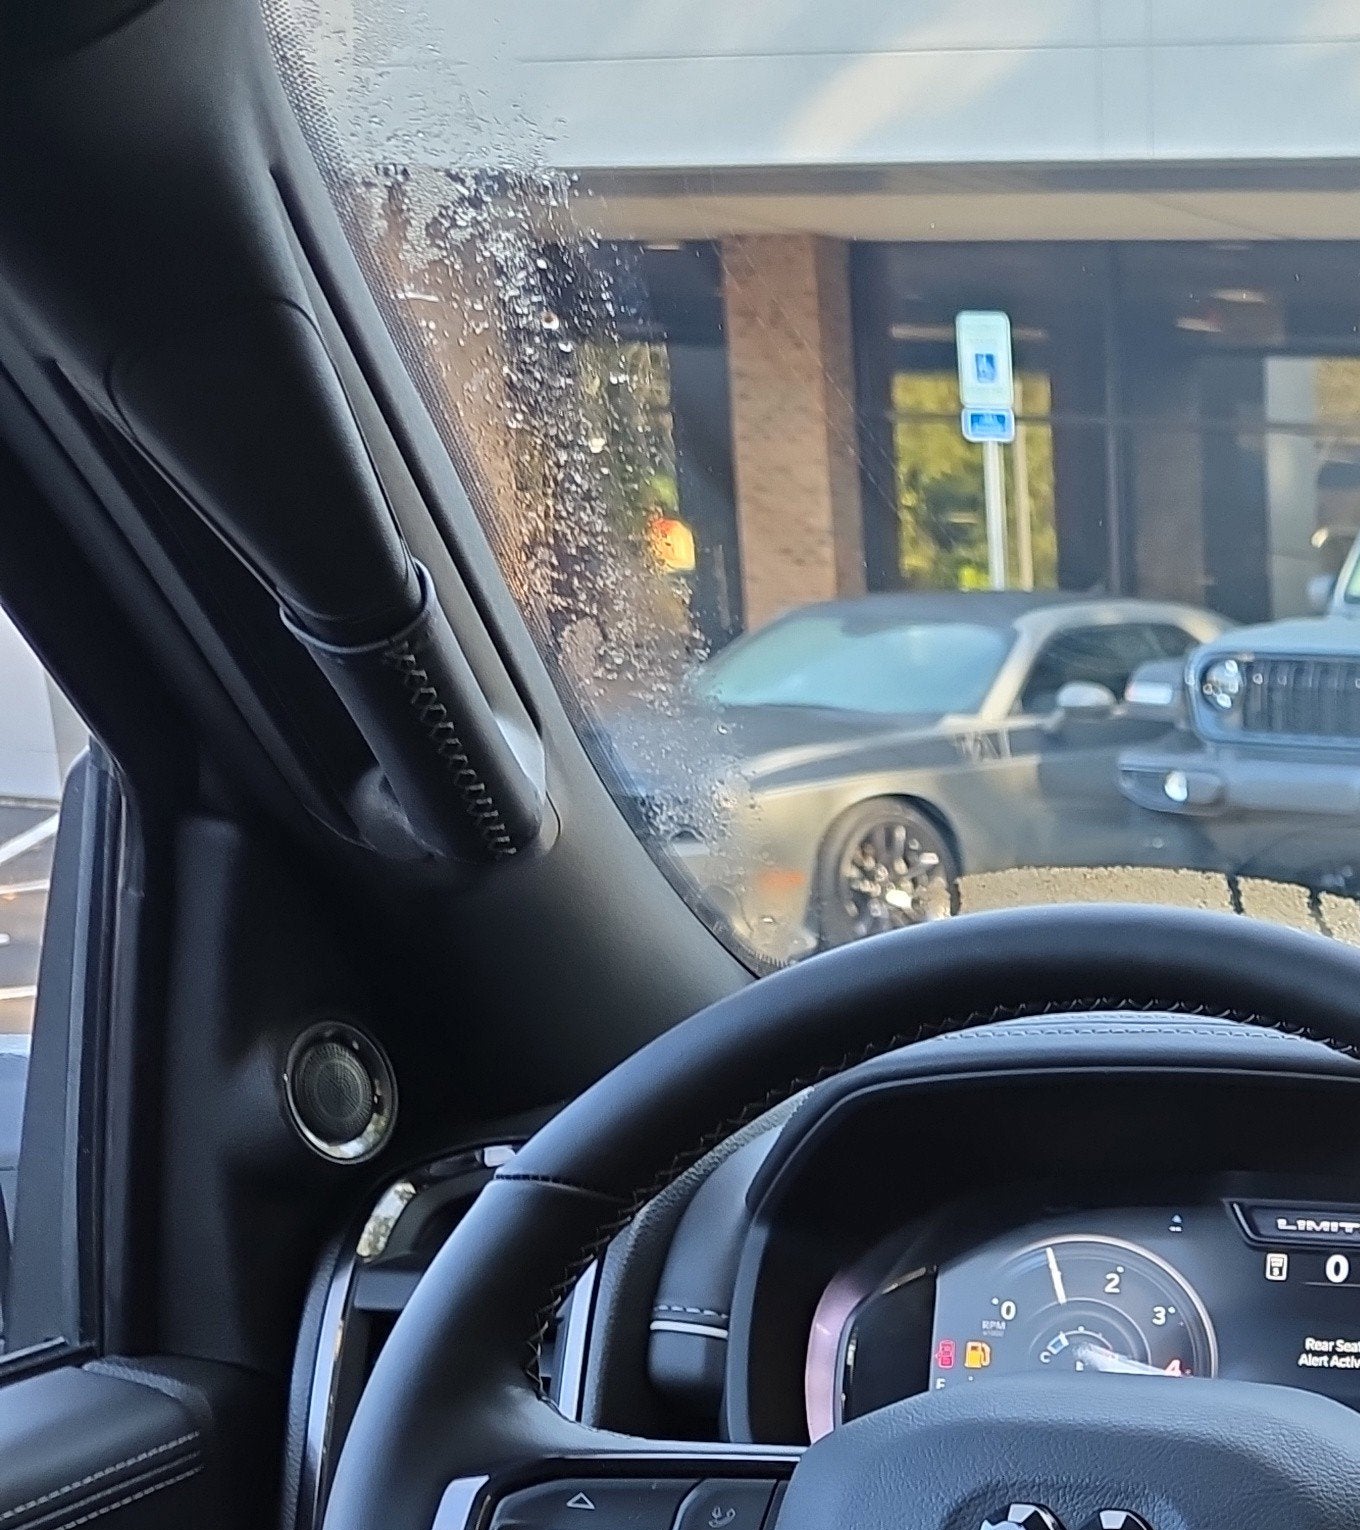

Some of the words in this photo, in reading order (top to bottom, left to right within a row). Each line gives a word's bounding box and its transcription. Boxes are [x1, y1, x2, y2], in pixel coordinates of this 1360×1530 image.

[1324, 1253, 1350, 1284] 0
[1104, 1272, 1121, 1294] 2
[1000, 1300, 1017, 1321] 0
[1152, 1306, 1168, 1326] 3
[981, 1319, 1007, 1330] RPM
[1304, 1336, 1334, 1353] Rear
[1297, 1353, 1329, 1369] Alert
